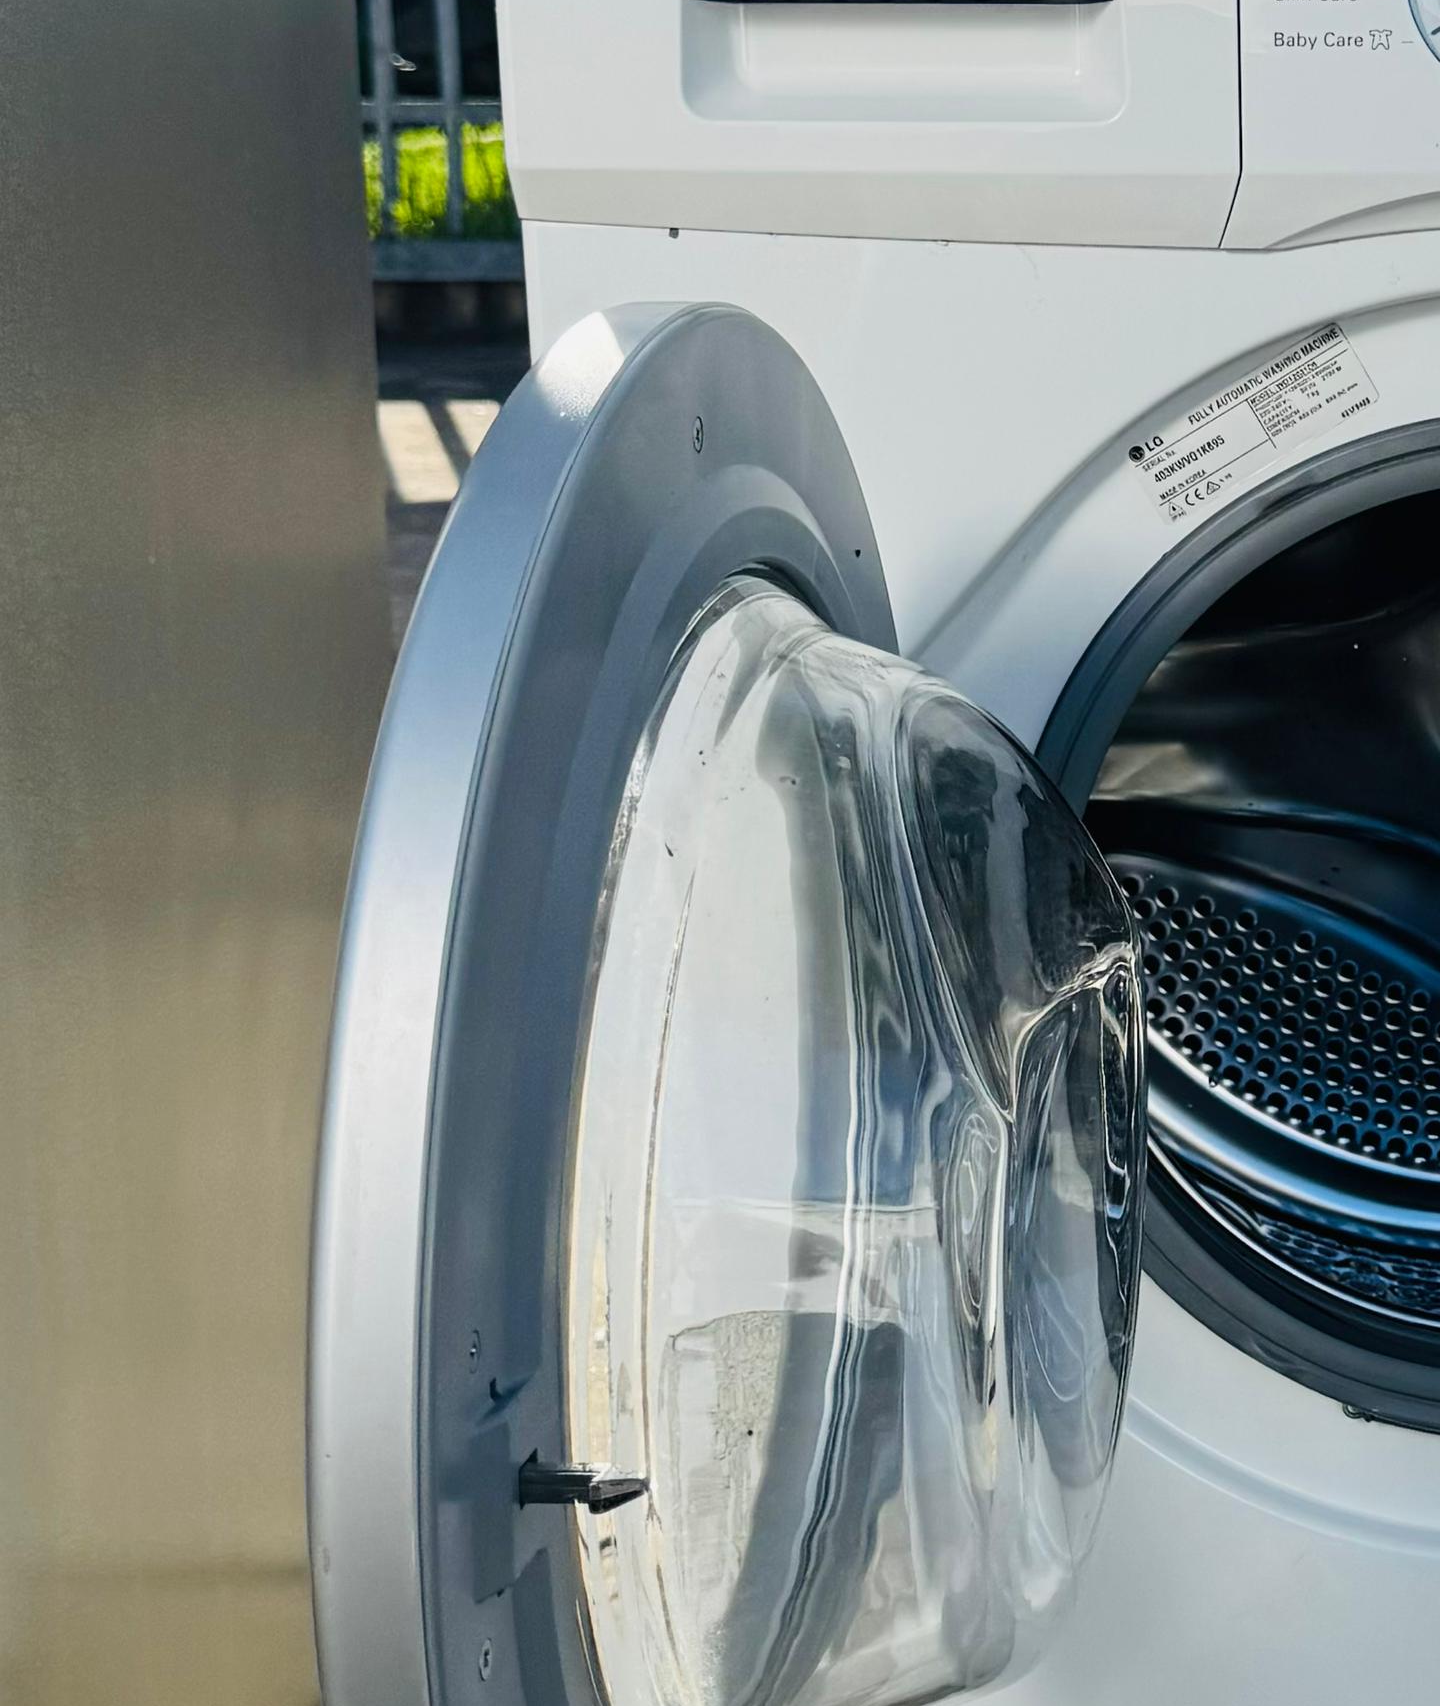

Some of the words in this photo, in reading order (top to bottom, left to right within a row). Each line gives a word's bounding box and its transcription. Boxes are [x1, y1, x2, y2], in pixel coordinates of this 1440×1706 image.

[1274, 32, 1315, 51] Baby
[1323, 32, 1364, 49] Care
[1187, 403, 1216, 425] FULLY
[1216, 376, 1263, 409] AUTOMATIC
